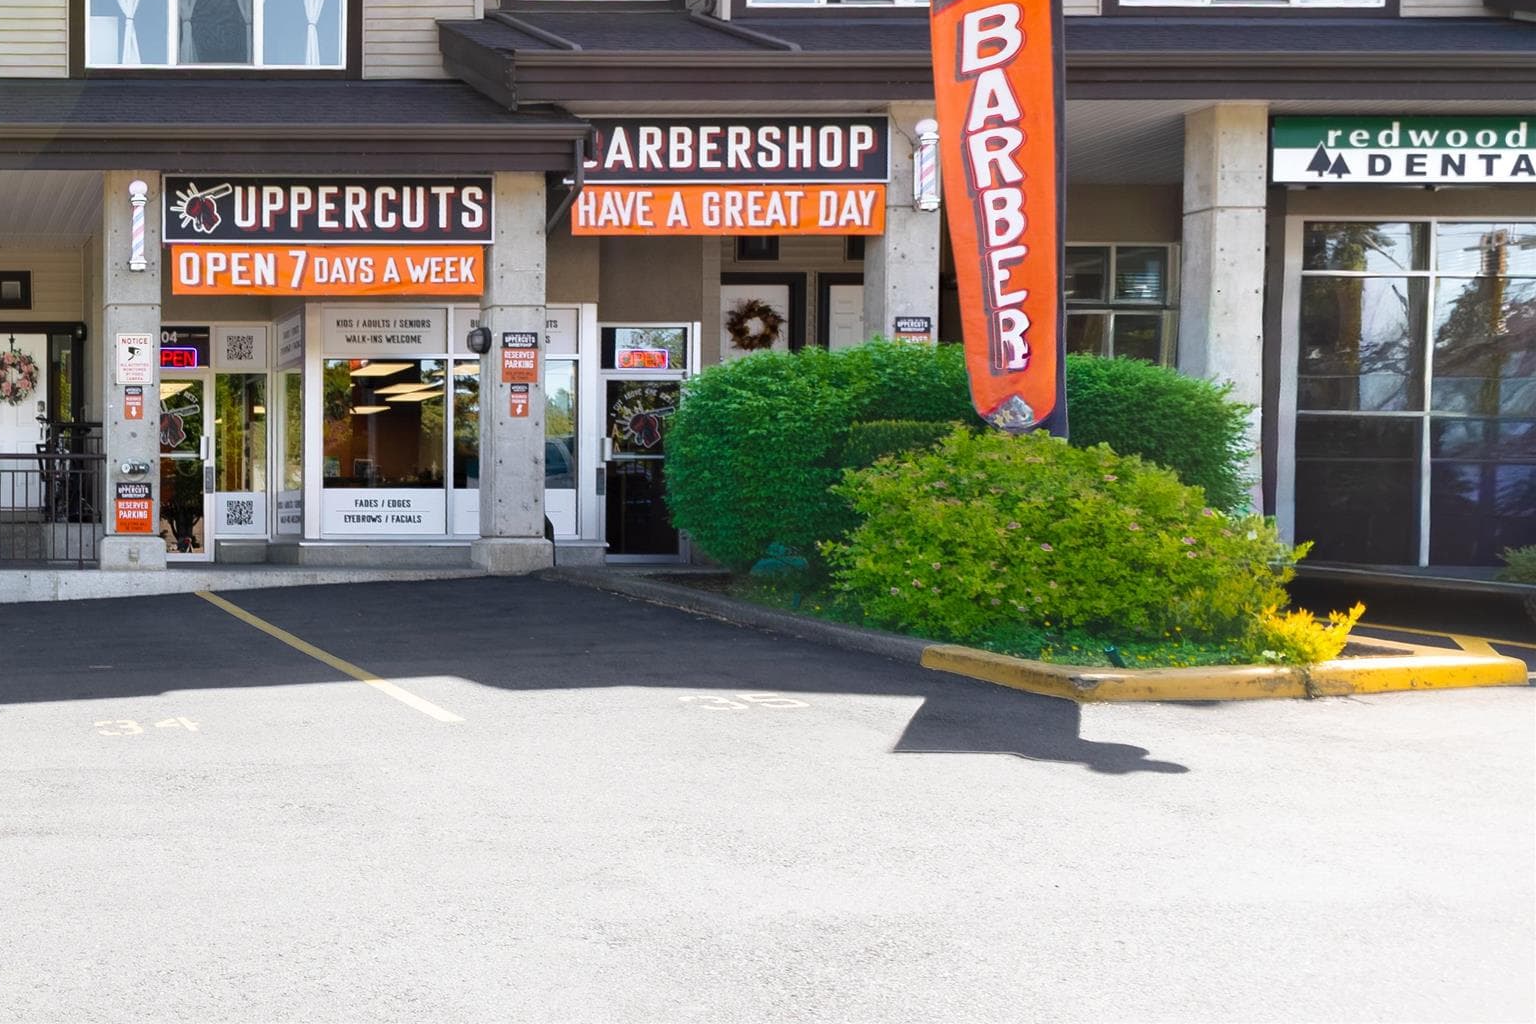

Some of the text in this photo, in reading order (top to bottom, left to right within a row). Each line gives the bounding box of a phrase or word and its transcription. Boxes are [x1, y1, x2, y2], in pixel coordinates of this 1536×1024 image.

[1327, 121, 1528, 147] redwood
[583, 125, 874, 170] ARBERSHOP
[1368, 153, 1536, 177] DENTA
[959, 2, 1031, 371] BARBER
[234, 185, 484, 229] UPPERCUTS
[577, 190, 876, 227] HAVE A GREAT DAY
[179, 250, 475, 288] OPEN 7 DAYS A WEEK
[336, 319, 353, 328] KIDS
[399, 319, 431, 328] SENIORS
[121, 337, 148, 345] NOTICE
[161, 331, 177, 343] 04
[385, 335, 422, 344] WELCOME
[161, 350, 195, 366] PEN
[504, 351, 535, 359] RESERVED
[619, 351, 666, 368] OPEN
[504, 360, 534, 369] PARKING
[354, 499, 378, 508] FADES
[387, 499, 411, 508] EDGES
[119, 510, 148, 519] PARKING
[344, 514, 382, 523] EYEBROWS
[391, 514, 422, 523] FACIALS
[678, 693, 810, 711] 35
[94, 716, 199, 736] 34
